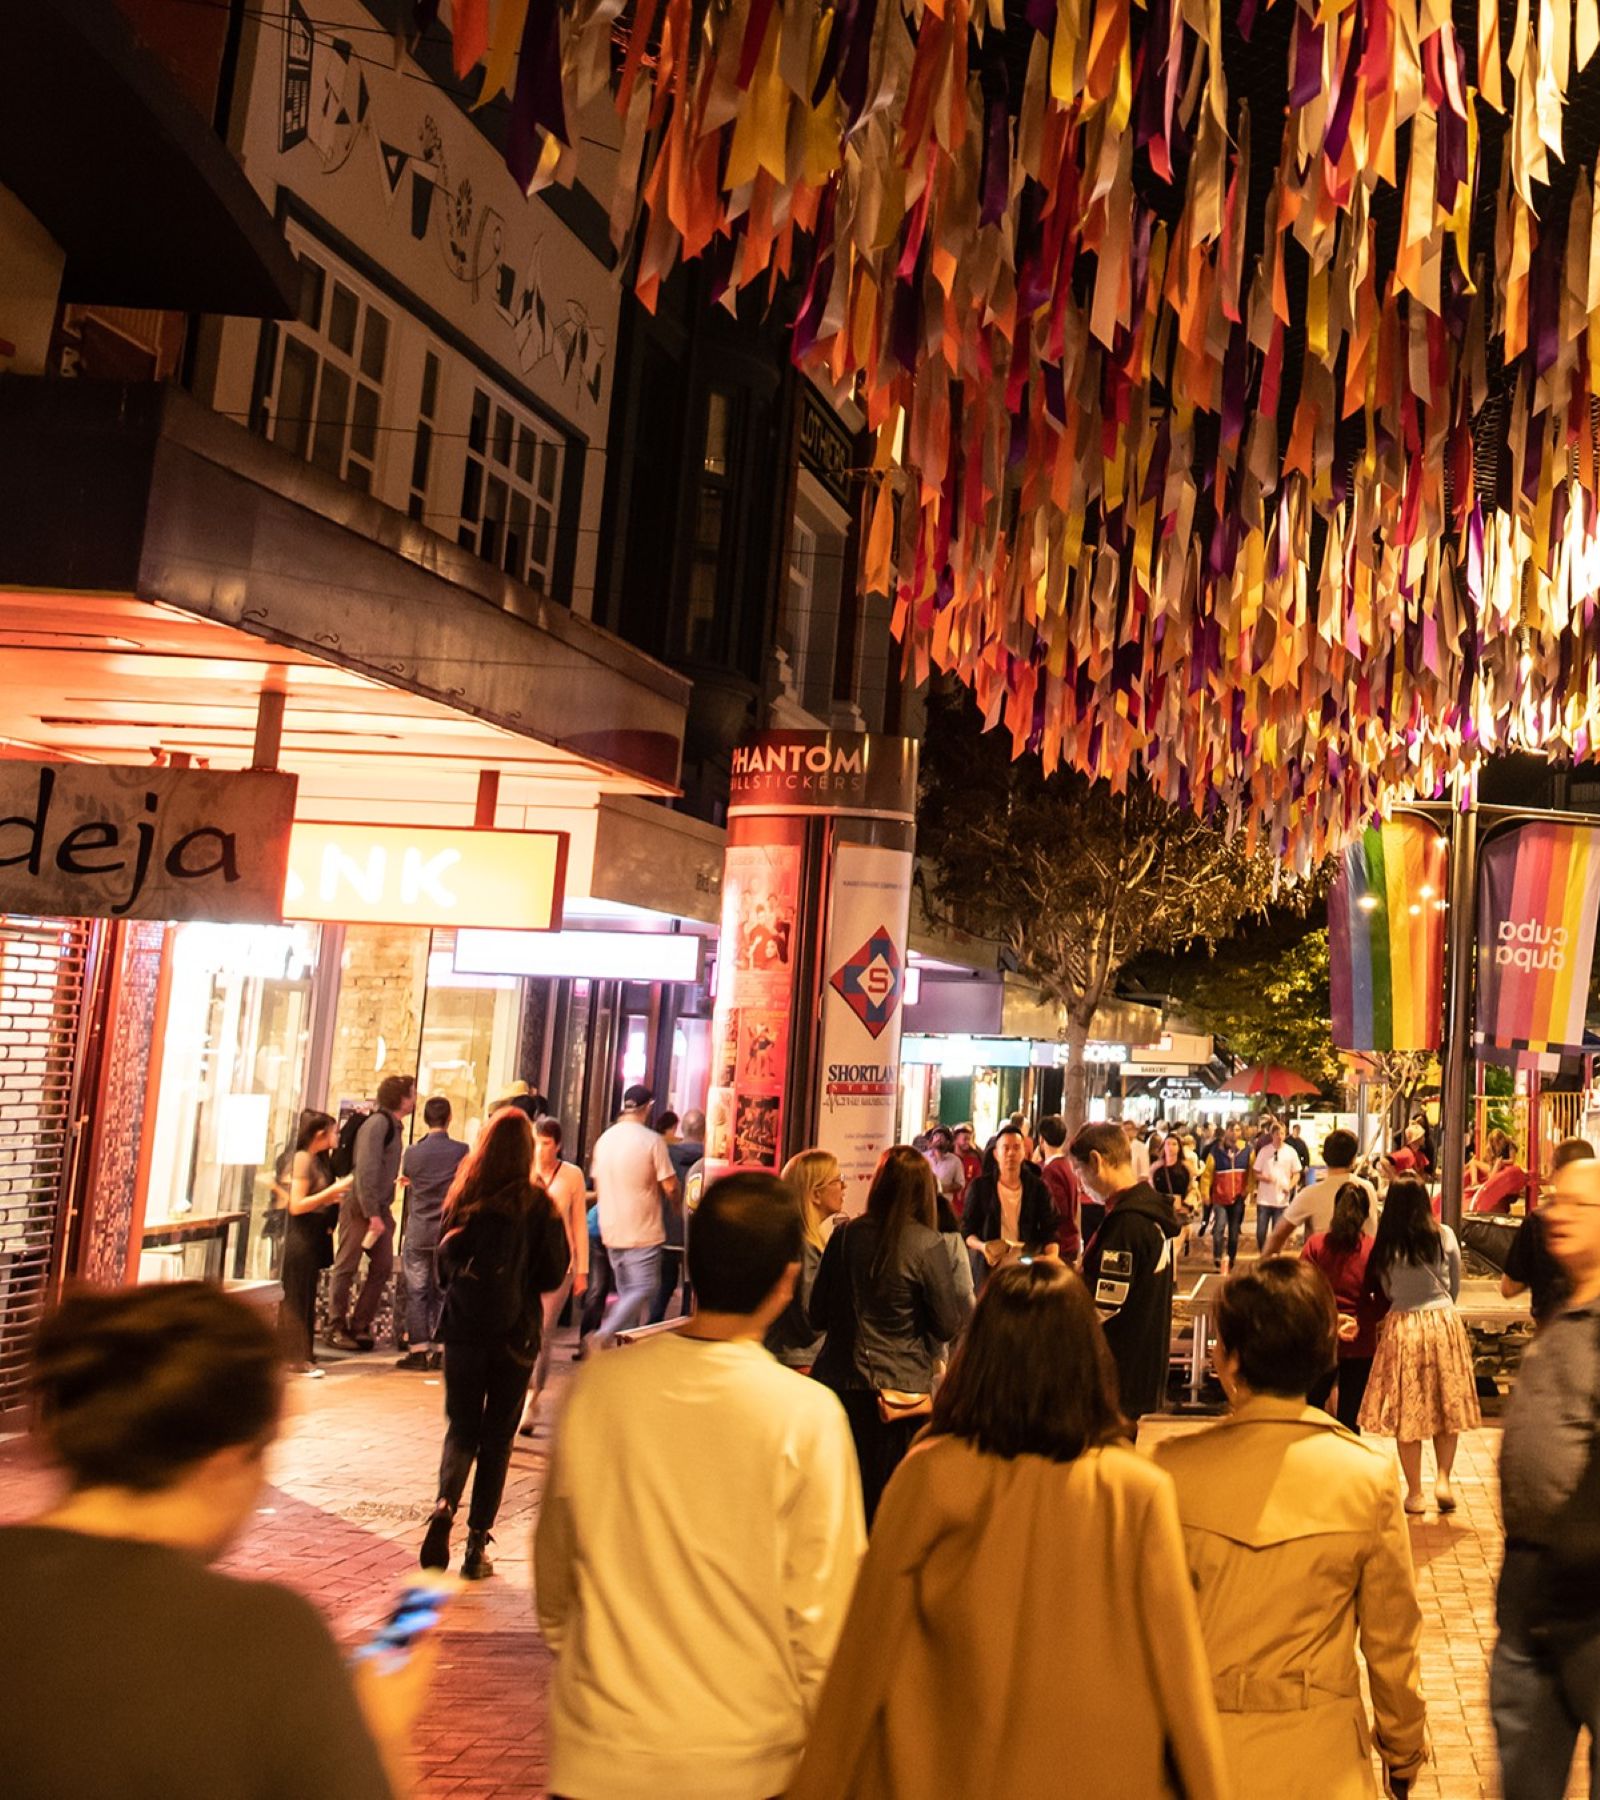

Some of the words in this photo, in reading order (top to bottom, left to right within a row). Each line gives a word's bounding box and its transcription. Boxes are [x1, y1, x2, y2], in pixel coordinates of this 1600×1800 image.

[731, 745, 861, 773] PHANTOM
[730, 775, 860, 790] ILLSTICKERS
[0, 768, 241, 914] deja
[868, 968, 888, 993] S
